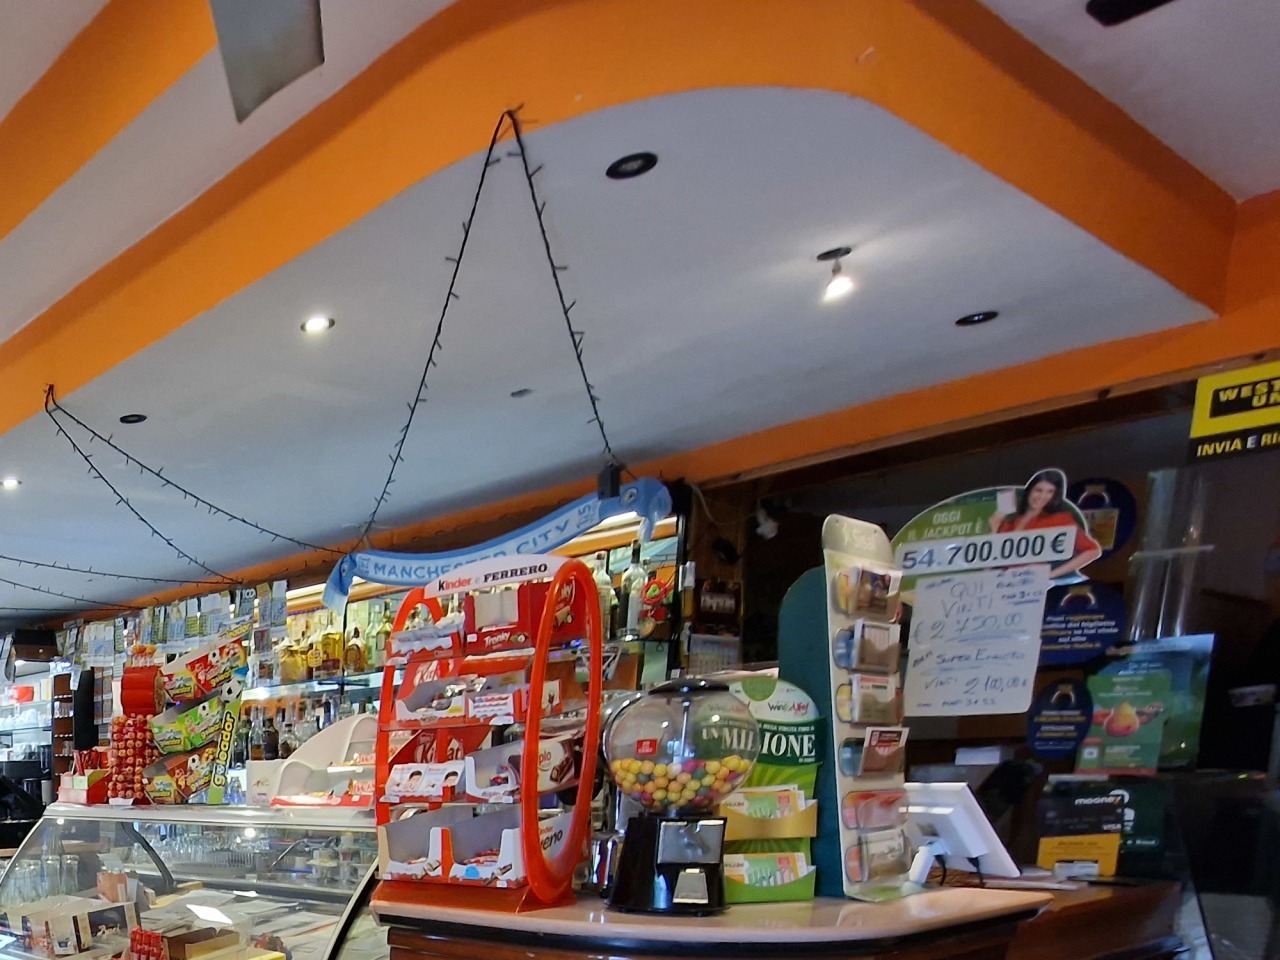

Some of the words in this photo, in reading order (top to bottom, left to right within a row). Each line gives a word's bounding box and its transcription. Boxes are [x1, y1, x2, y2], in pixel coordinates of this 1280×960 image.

[1196, 437, 1242, 457] INVIA
[1246, 435, 1257, 449] E
[932, 511, 961, 525] OGGI
[924, 521, 973, 540] JACKPOT
[373, 550, 507, 579] MANCHE
[516, 518, 570, 555] CITY
[901, 534, 1046, 570] 54.700.000
[1050, 532, 1068, 554] €
[483, 564, 548, 583] FERRERO
[483, 631, 511, 649] Tronky
[213, 711, 235, 787] goleador
[720, 727, 816, 757] MILIONE
